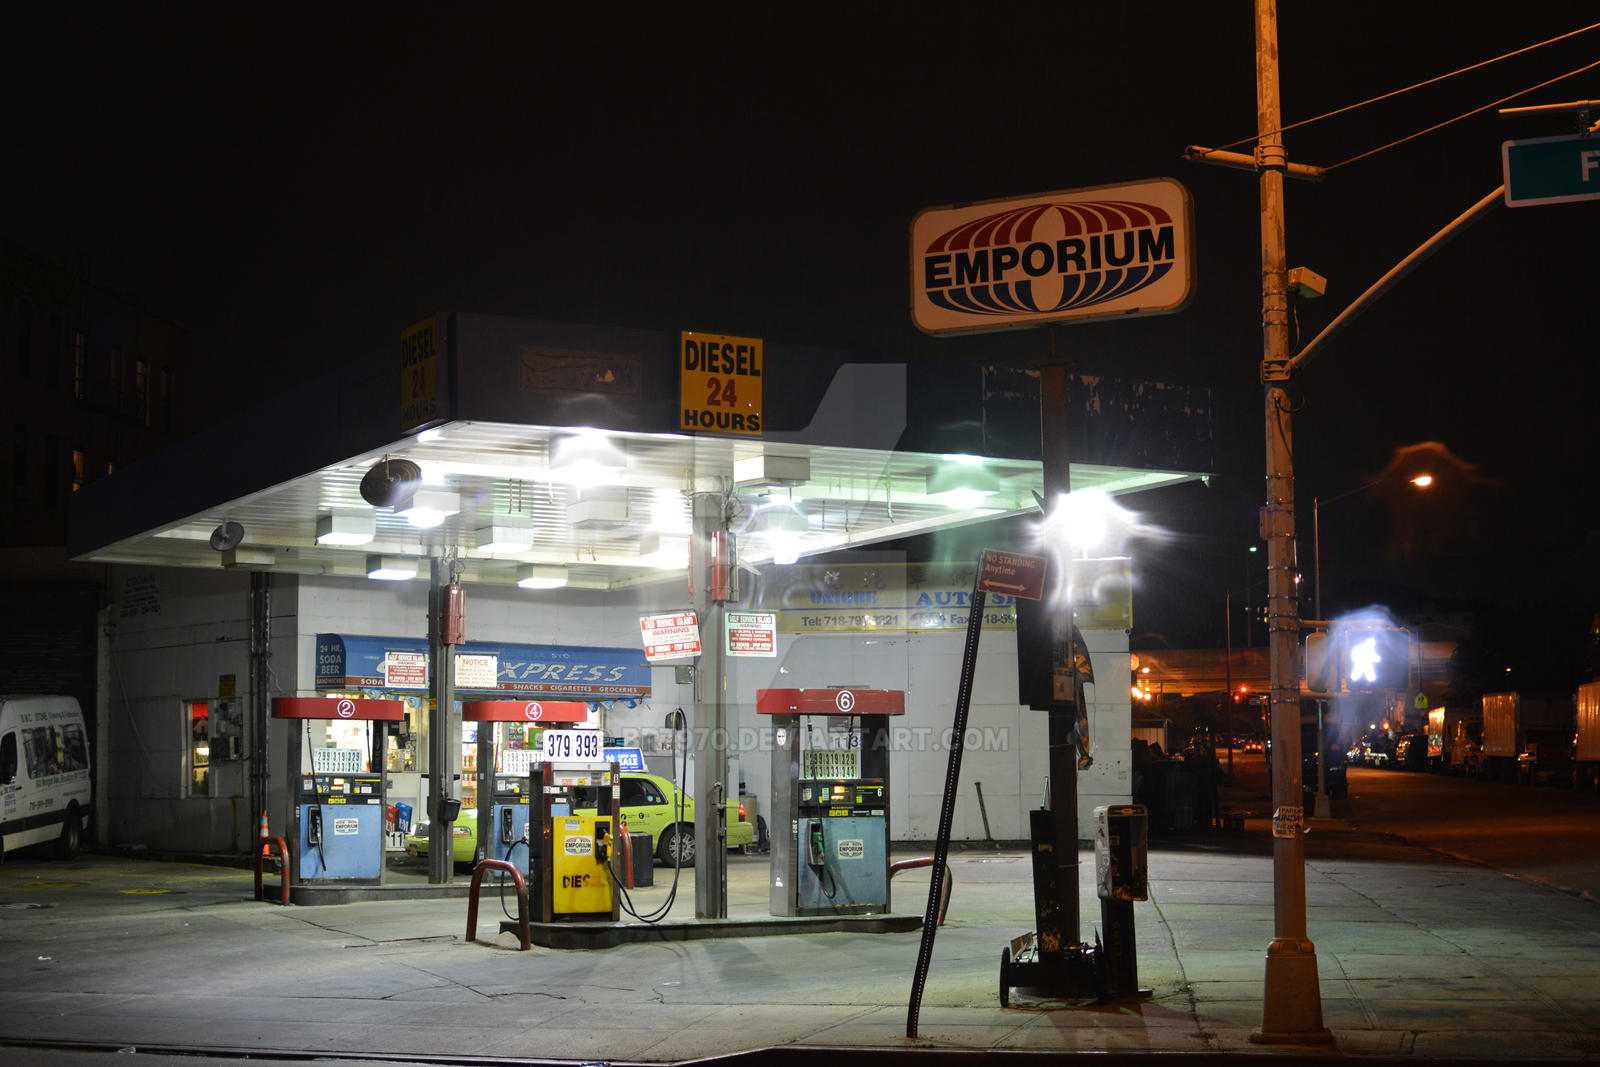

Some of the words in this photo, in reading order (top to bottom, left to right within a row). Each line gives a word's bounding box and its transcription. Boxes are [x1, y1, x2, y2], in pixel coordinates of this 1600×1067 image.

[925, 226, 1175, 288] EMPORIUM
[401, 327, 435, 368] DIESEL
[685, 340, 760, 377] DIESEL
[707, 377, 738, 407] 24
[402, 397, 437, 424] HOURS
[684, 409, 760, 431] HOURS
[985, 553, 998, 563] NO
[1000, 556, 1036, 568] STANDING
[985, 563, 1017, 575] Anytime
[801, 616, 821, 626] Tel:
[652, 627, 690, 636] WARNING
[319, 654, 342, 664] SODA
[463, 658, 489, 666] NOTICE
[321, 664, 340, 674] BEER
[497, 662, 627, 682] XPRESS
[341, 701, 351, 714] 2
[840, 694, 850, 709] 6
[529, 705, 538, 717] 4
[548, 735, 571, 757] 379
[576, 735, 598, 758] 393
[618, 757, 639, 766] SALE
